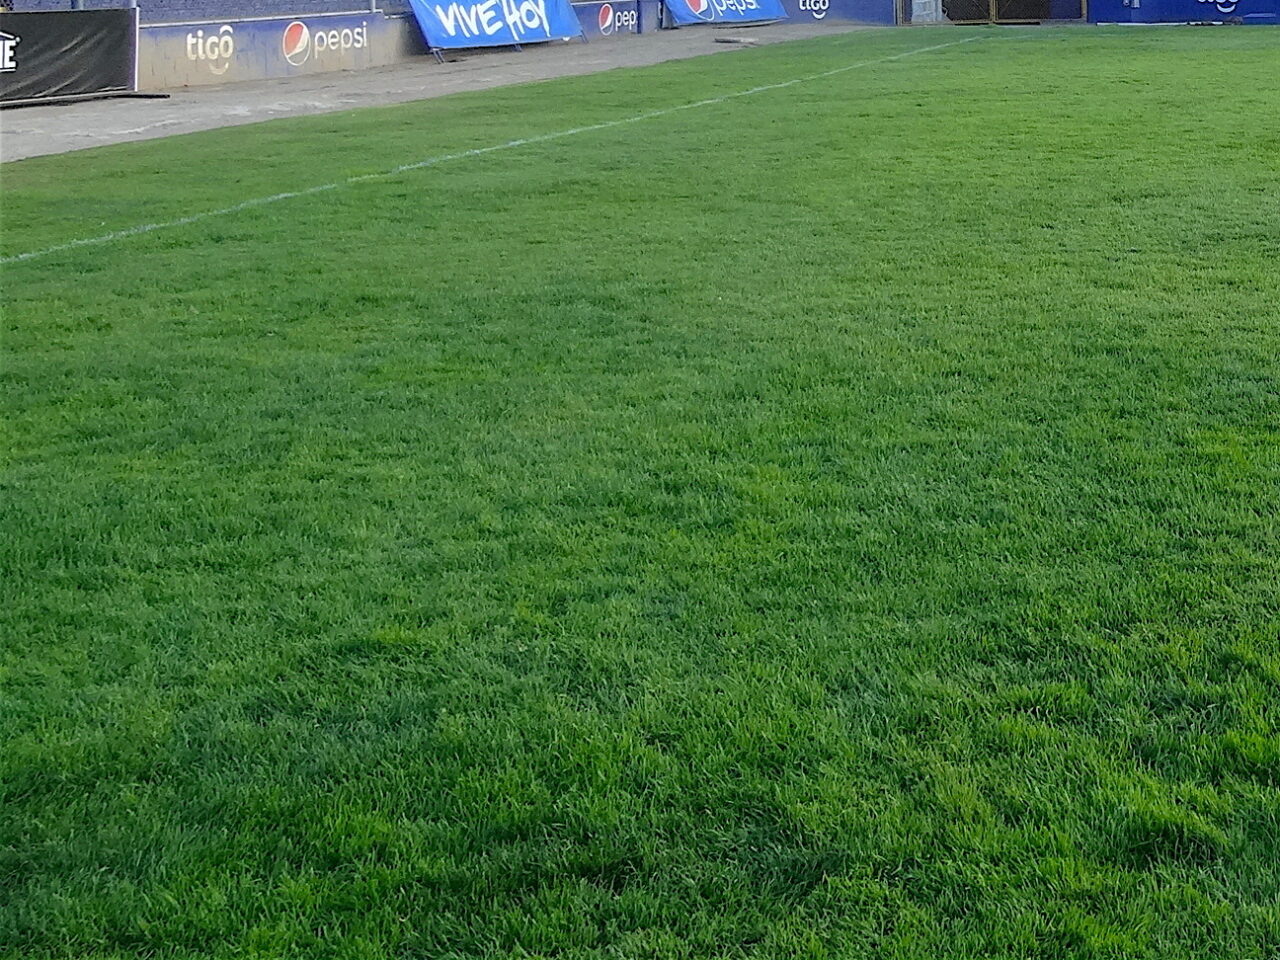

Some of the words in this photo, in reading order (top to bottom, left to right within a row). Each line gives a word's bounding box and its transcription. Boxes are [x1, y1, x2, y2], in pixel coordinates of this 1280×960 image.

[435, 0, 503, 38] VIVE
[615, 10, 638, 31] pep
[186, 25, 234, 61] tigo
[314, 22, 368, 61] pepsi
